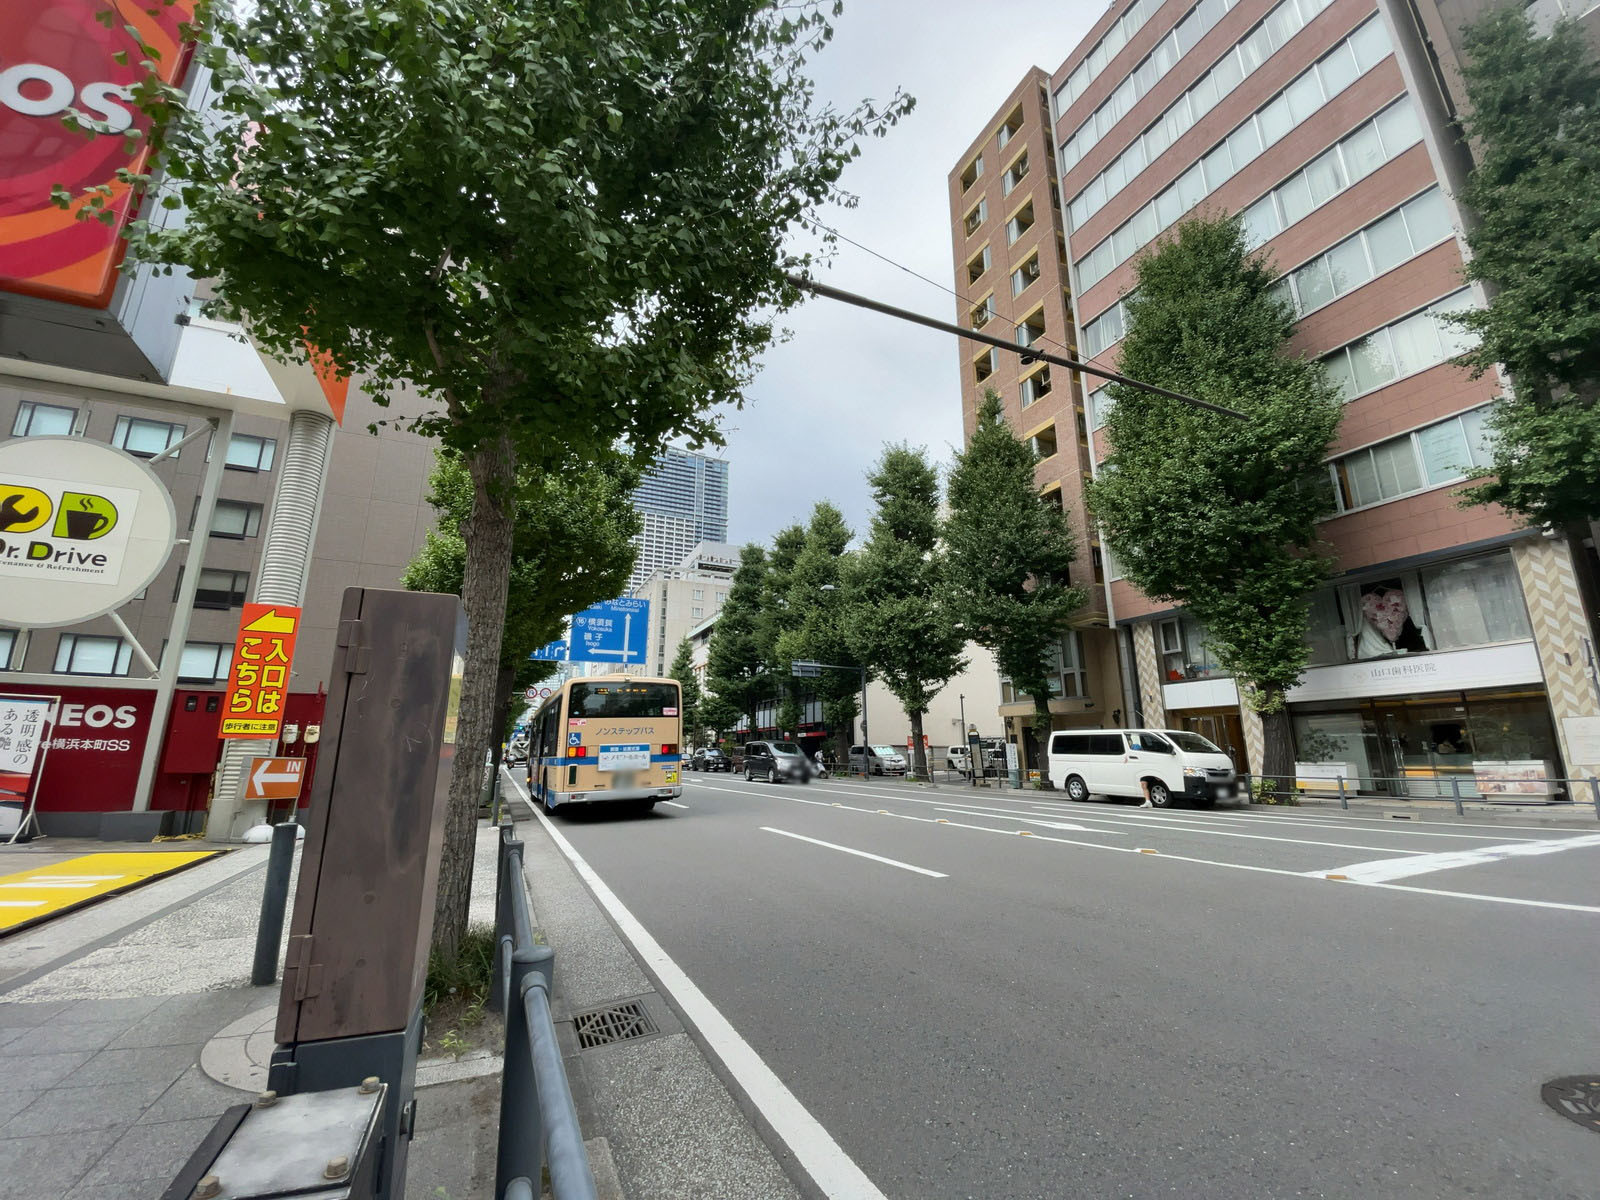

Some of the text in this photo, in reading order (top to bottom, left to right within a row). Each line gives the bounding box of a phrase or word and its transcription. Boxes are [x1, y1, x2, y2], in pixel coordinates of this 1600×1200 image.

[0, 538, 108, 567] r. Drive
[46, 564, 105, 574] Refreshment
[229, 636, 263, 714] こちら
[255, 638, 289, 714] 入口は
[1370, 662, 1437, 678] 山口歯科医院
[225, 722, 276, 732] 歩行者に注意
[595, 727, 655, 736] ノンステップバス
[12, 709, 41, 765] 透明感の
[286, 760, 302, 772] IN
